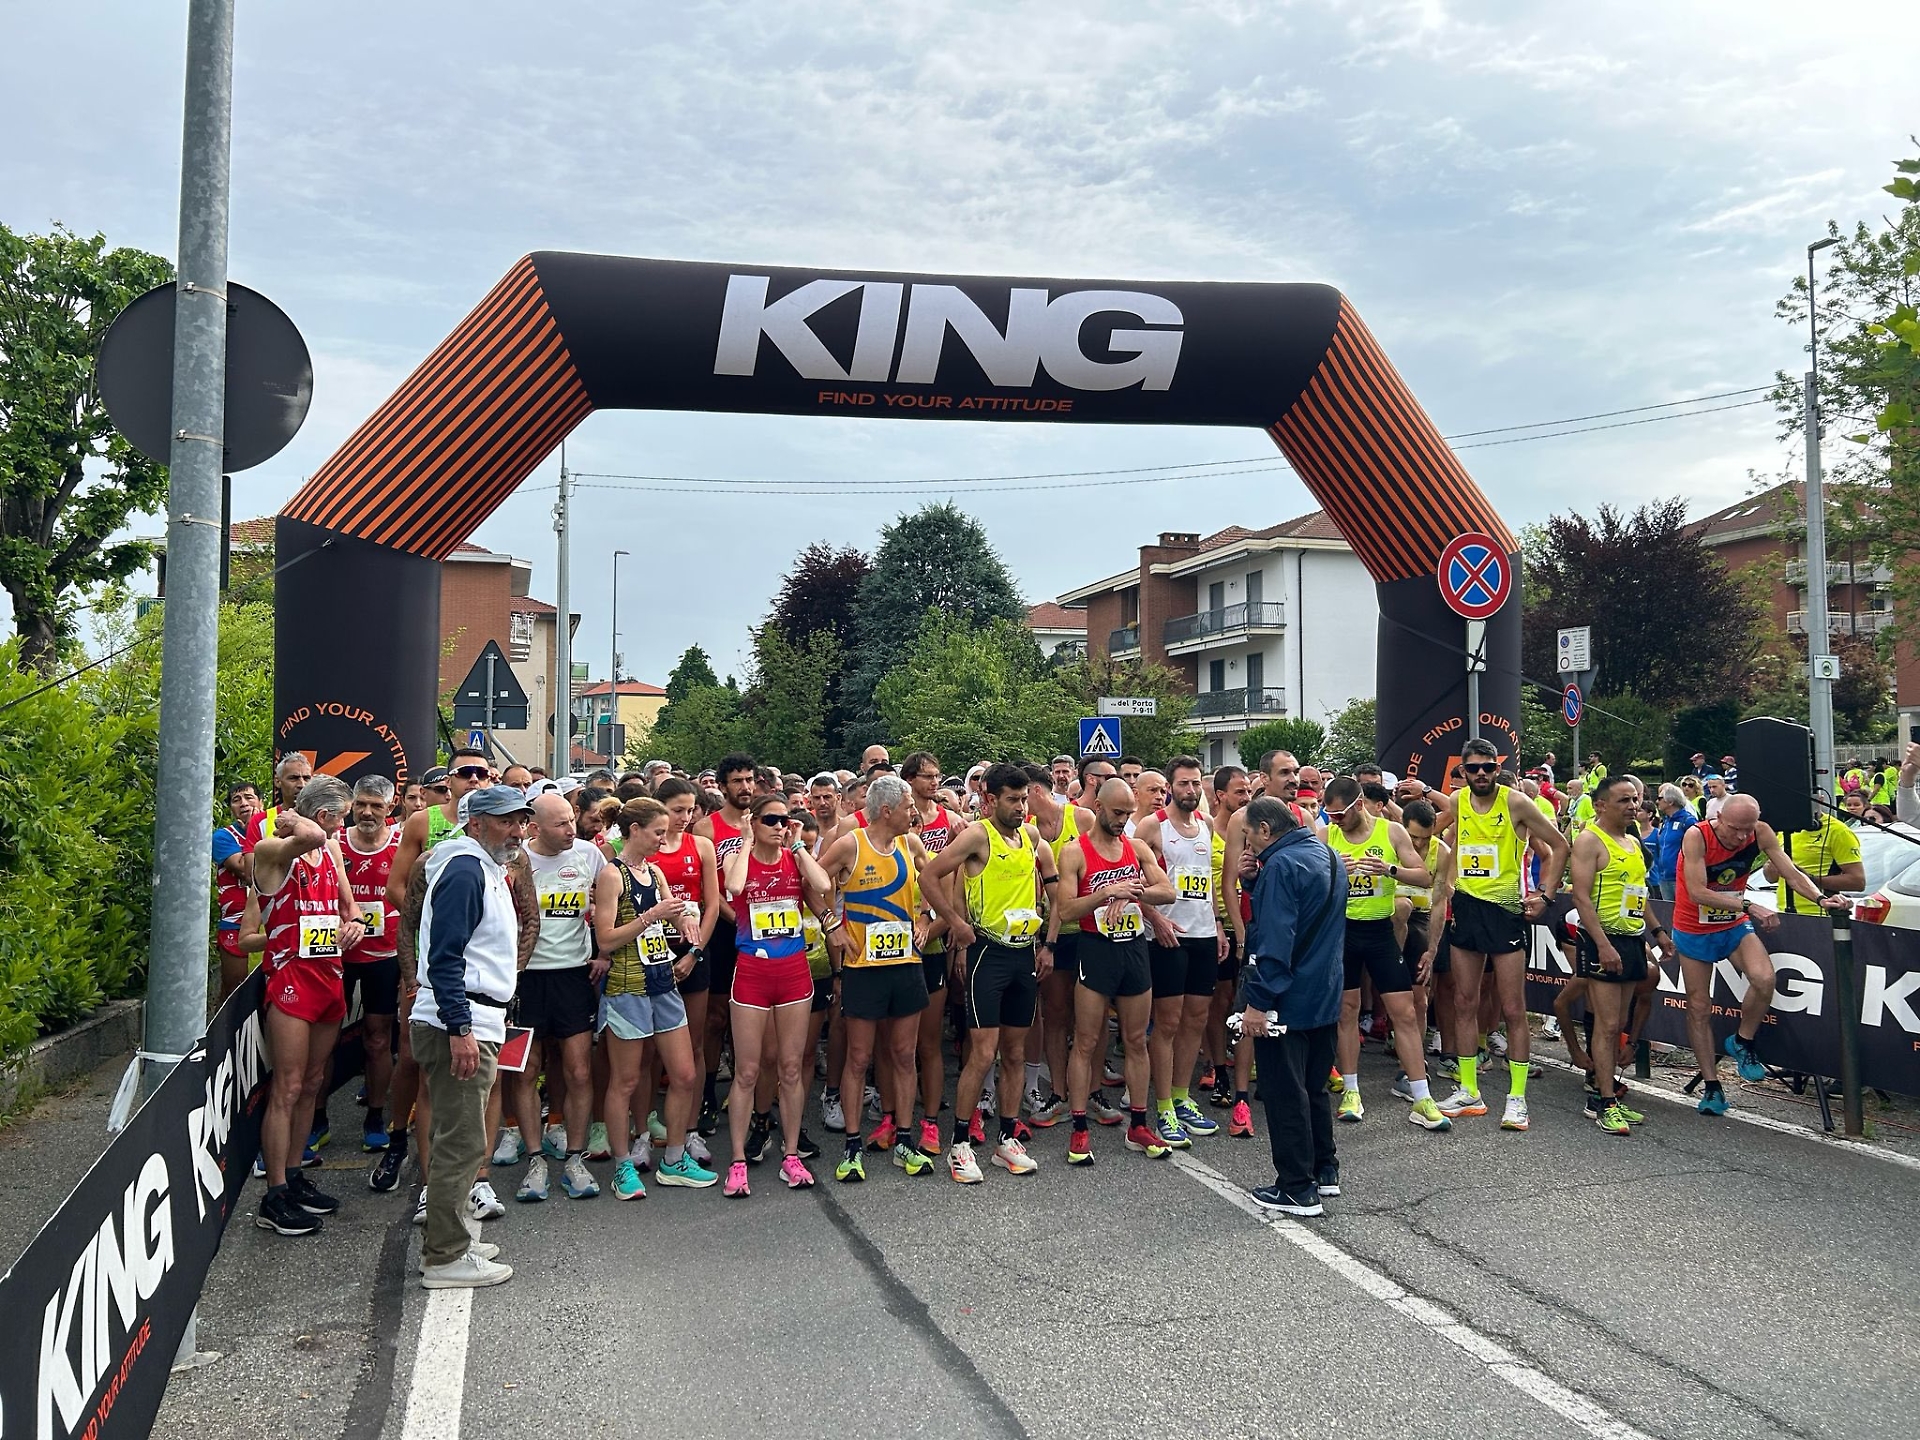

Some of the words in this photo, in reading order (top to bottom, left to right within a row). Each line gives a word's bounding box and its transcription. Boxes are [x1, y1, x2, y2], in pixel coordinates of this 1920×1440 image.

[713, 274, 1185, 391] KING
[818, 391, 875, 406] FIND
[883, 394, 953, 409] YOUR
[957, 397, 1073, 412] ATTITUDE
[1117, 699, 1130, 707] del
[1132, 699, 1153, 707] Porto
[280, 706, 311, 740] FIND
[315, 702, 376, 727] YOUR
[1422, 717, 1463, 746] FIND
[1479, 712, 1511, 732] OUR
[921, 827, 948, 840] ETICA
[717, 837, 744, 852] ATLE
[1471, 855, 1480, 869] 3
[1090, 865, 1136, 885] ATLETICA
[1184, 875, 1208, 892] 139
[548, 892, 580, 909] 144
[747, 890, 770, 899] A.S.D.
[767, 911, 786, 928] 11
[1020, 920, 1029, 935] 2
[309, 928, 337, 946] 275
[875, 933, 904, 950] 331
[1534, 974, 1553, 985] YOUR
[37, 1153, 175, 1440] KING
[97, 1373, 120, 1427] YOUR
[119, 1316, 152, 1390] ATTITUDE
